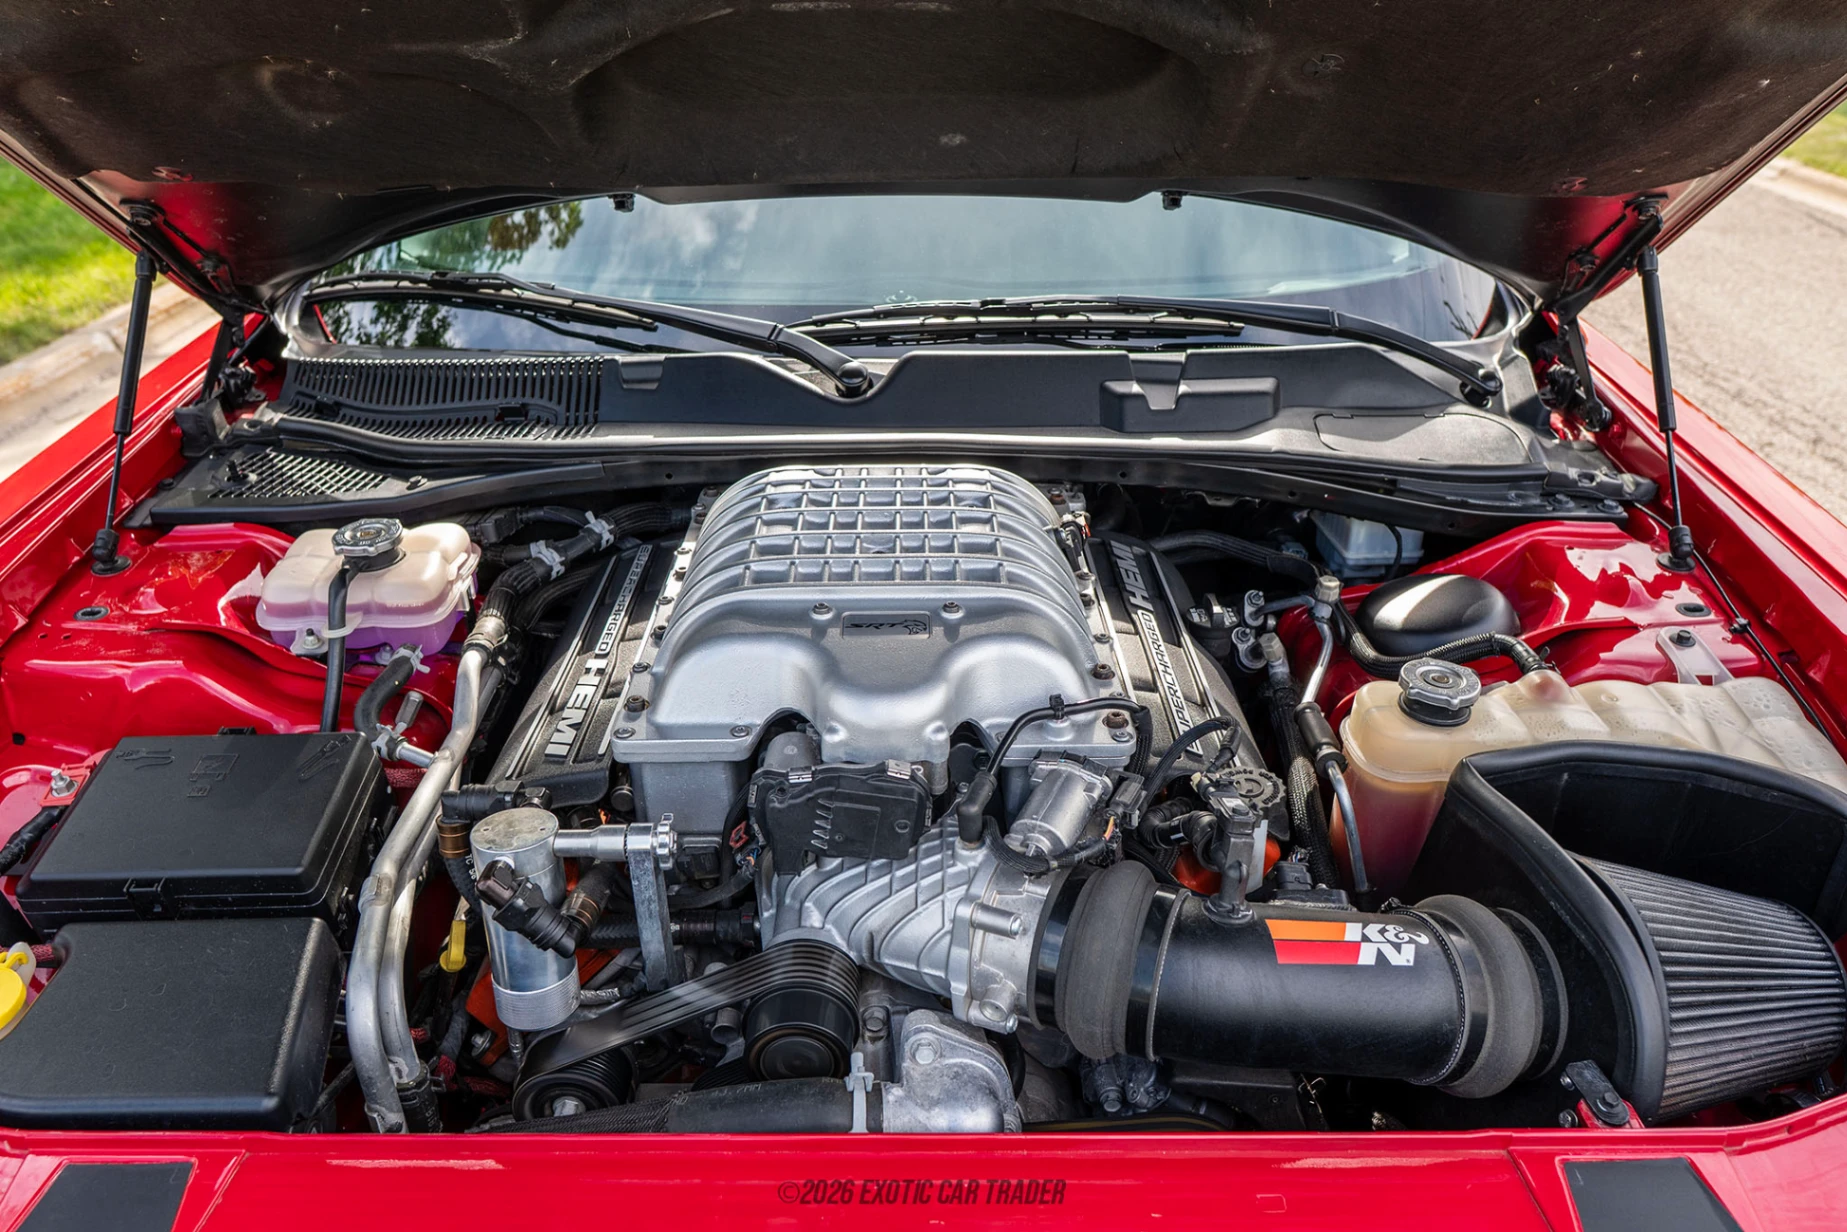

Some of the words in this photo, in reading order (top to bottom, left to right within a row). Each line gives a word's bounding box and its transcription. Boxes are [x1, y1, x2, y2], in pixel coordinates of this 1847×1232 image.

[598, 545, 651, 652] SUPERCHARGED
[1110, 540, 1154, 611] HEMI
[845, 622, 904, 630] SRT
[545, 659, 608, 757] HEMI
[1140, 612, 1200, 753] PERCHARGED
[1344, 922, 1429, 966] K&N
